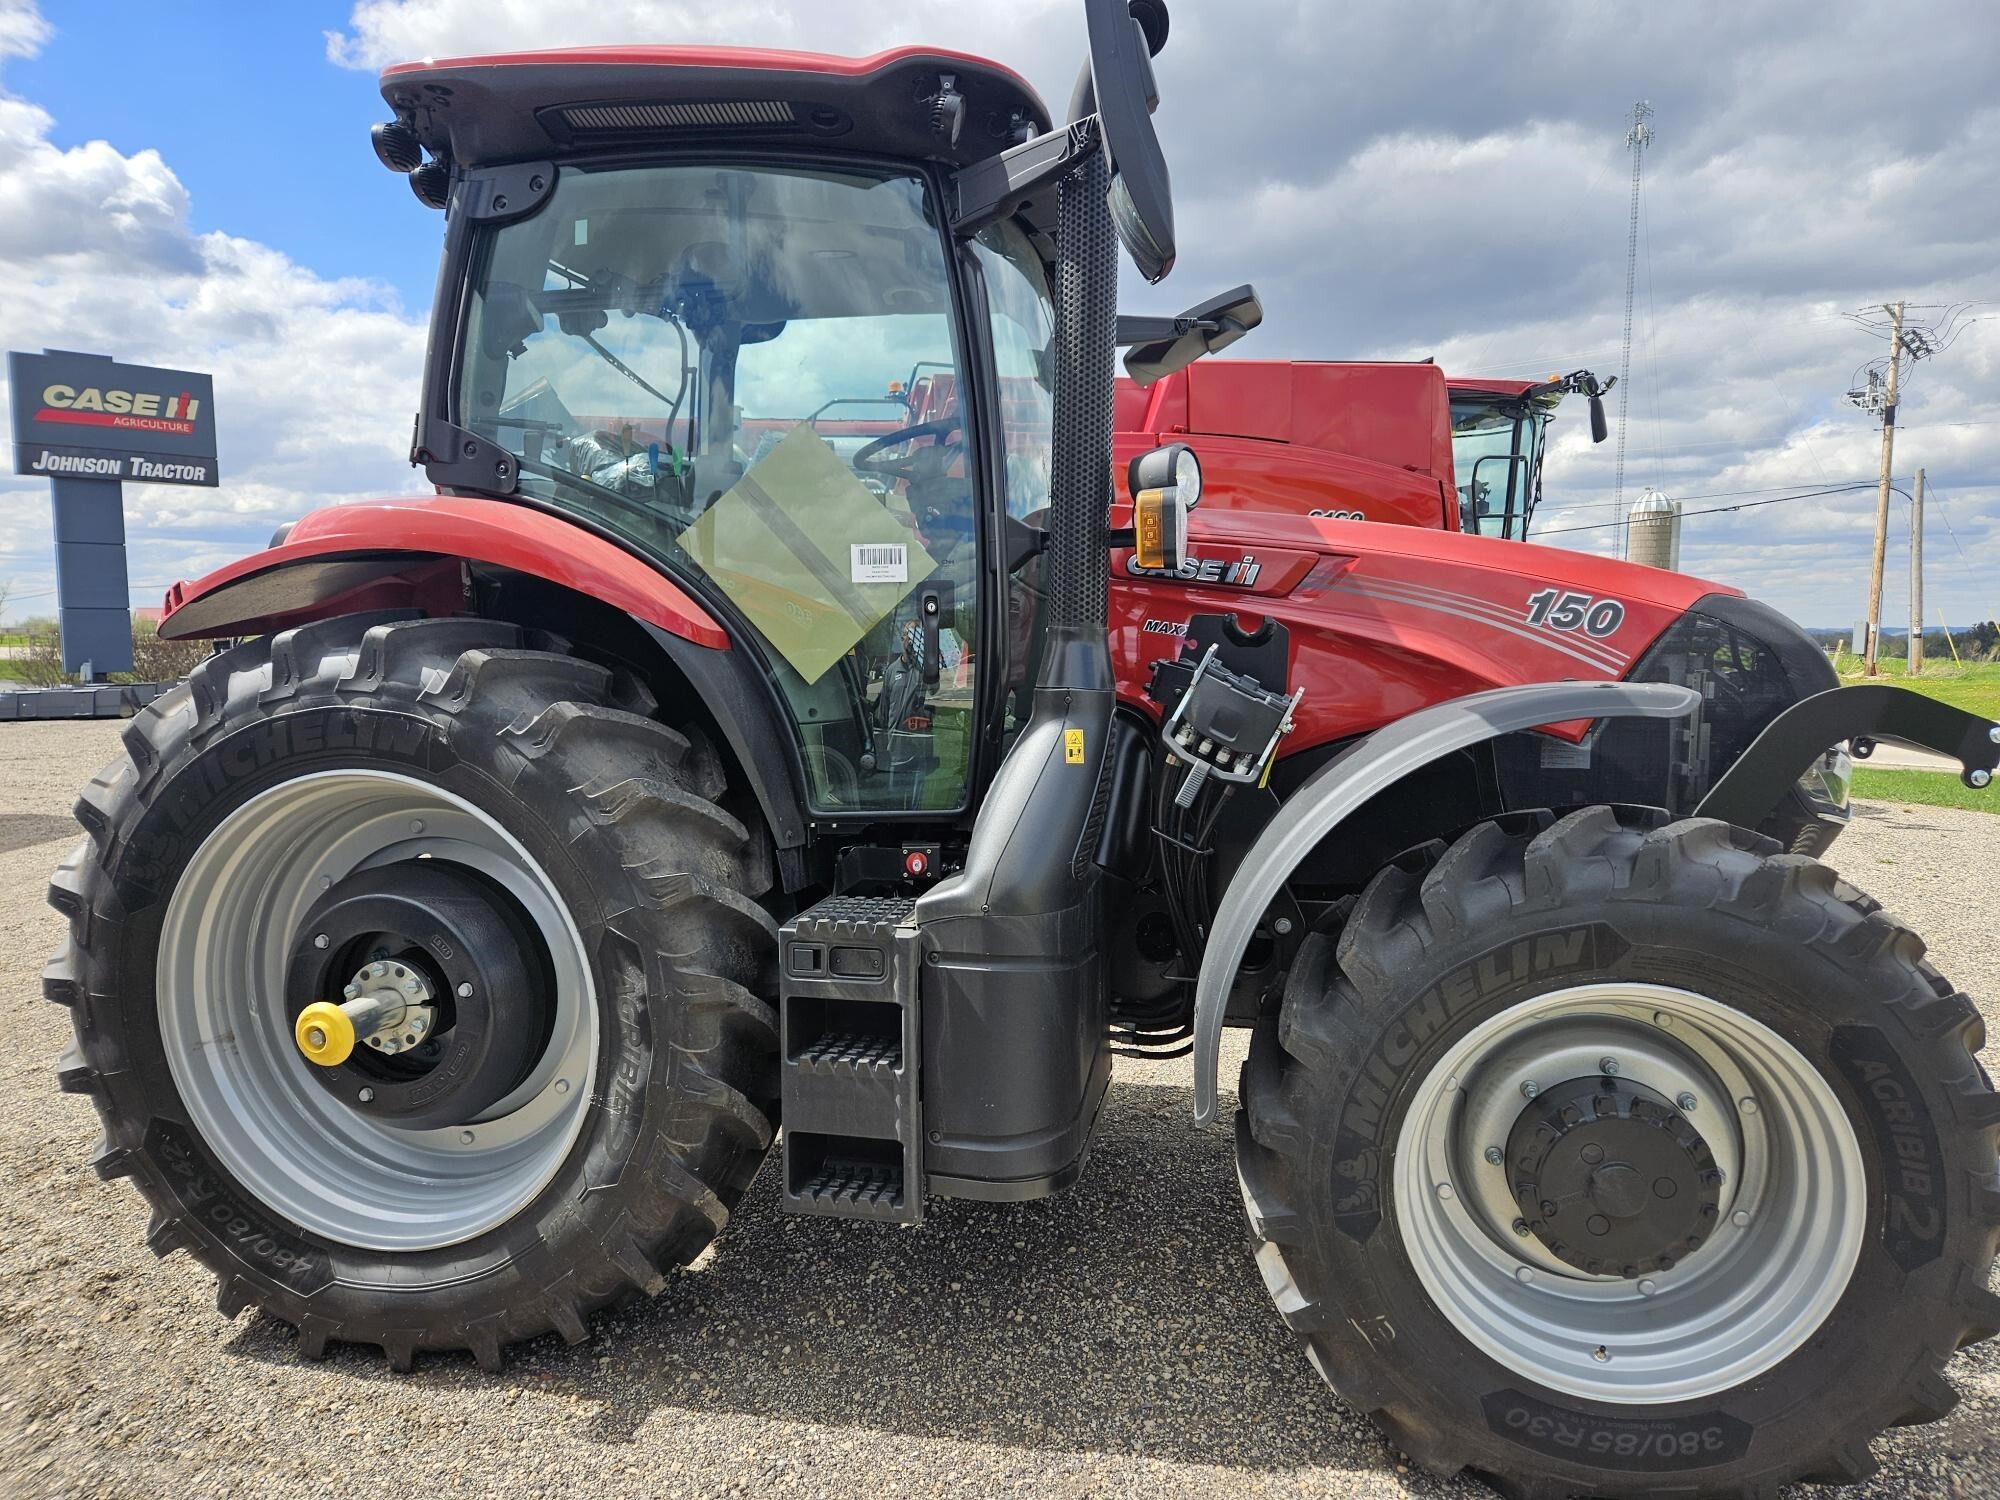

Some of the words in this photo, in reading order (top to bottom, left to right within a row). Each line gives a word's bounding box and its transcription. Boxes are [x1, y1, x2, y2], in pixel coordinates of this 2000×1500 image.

[42, 384, 160, 417] CASE
[113, 416, 191, 433] AGRICULTURE
[1126, 554, 1225, 581] CSE
[1526, 588, 1625, 638] 150
[166, 711, 429, 830] MICHELIN
[1343, 929, 1588, 1141] MICHELIN
[1853, 1059, 1933, 1197] AGRIBIB
[210, 1203, 314, 1275] 480/80
[1588, 1425, 1725, 1457] 380/85
